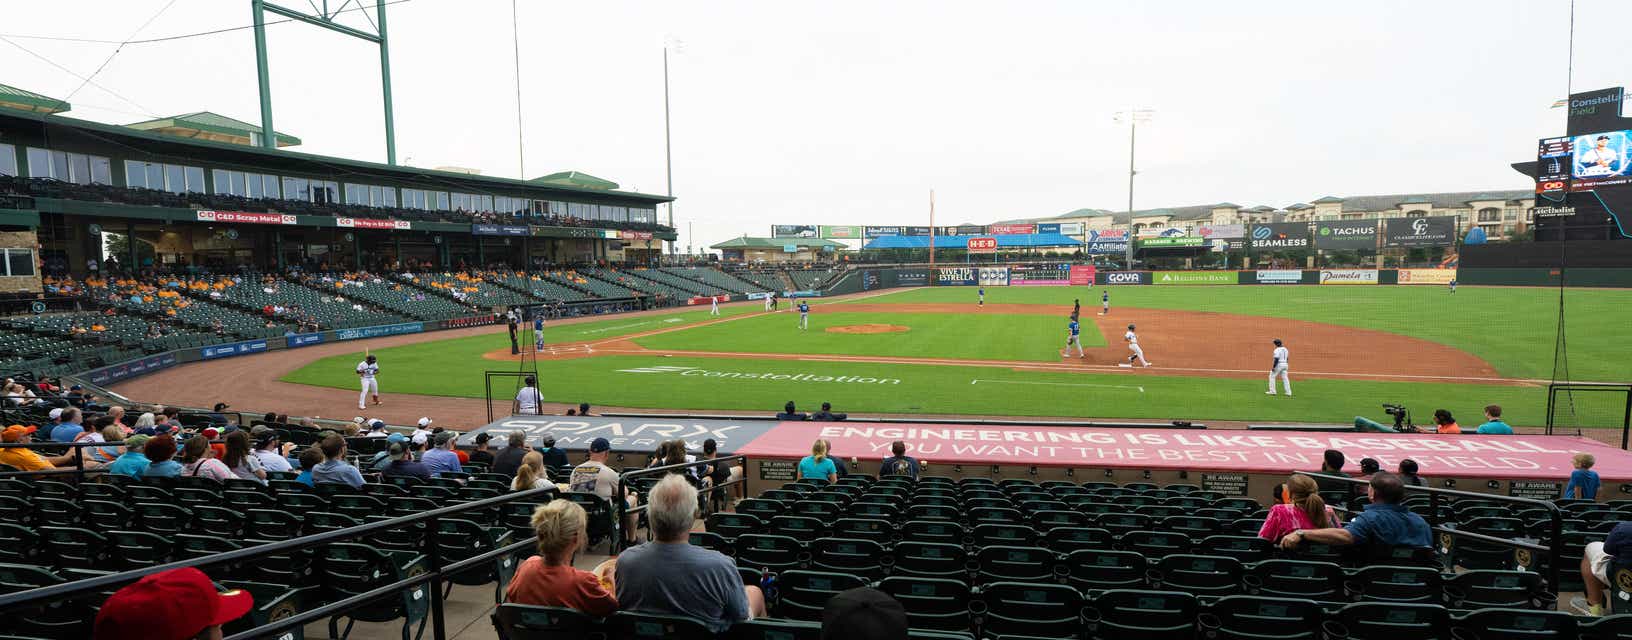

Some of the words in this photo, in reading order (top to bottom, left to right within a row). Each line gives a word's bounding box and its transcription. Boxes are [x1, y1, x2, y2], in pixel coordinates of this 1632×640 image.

[236, 214, 258, 222] Scrap
[1333, 226, 1375, 235] TACHUS
[1252, 238, 1307, 248] SEAMLESS
[1108, 273, 1139, 282] GOYA
[680, 369, 900, 384] Constellation
[487, 420, 742, 438] SPARX
[820, 426, 1116, 444] ENGINEERING
[1124, 433, 1168, 444] IS
[1173, 433, 1287, 448] LIKE
[952, 444, 1063, 457] WANT
[1072, 447, 1150, 460] THE
[1157, 449, 1250, 462] BEST
[1263, 451, 1311, 464] IN
